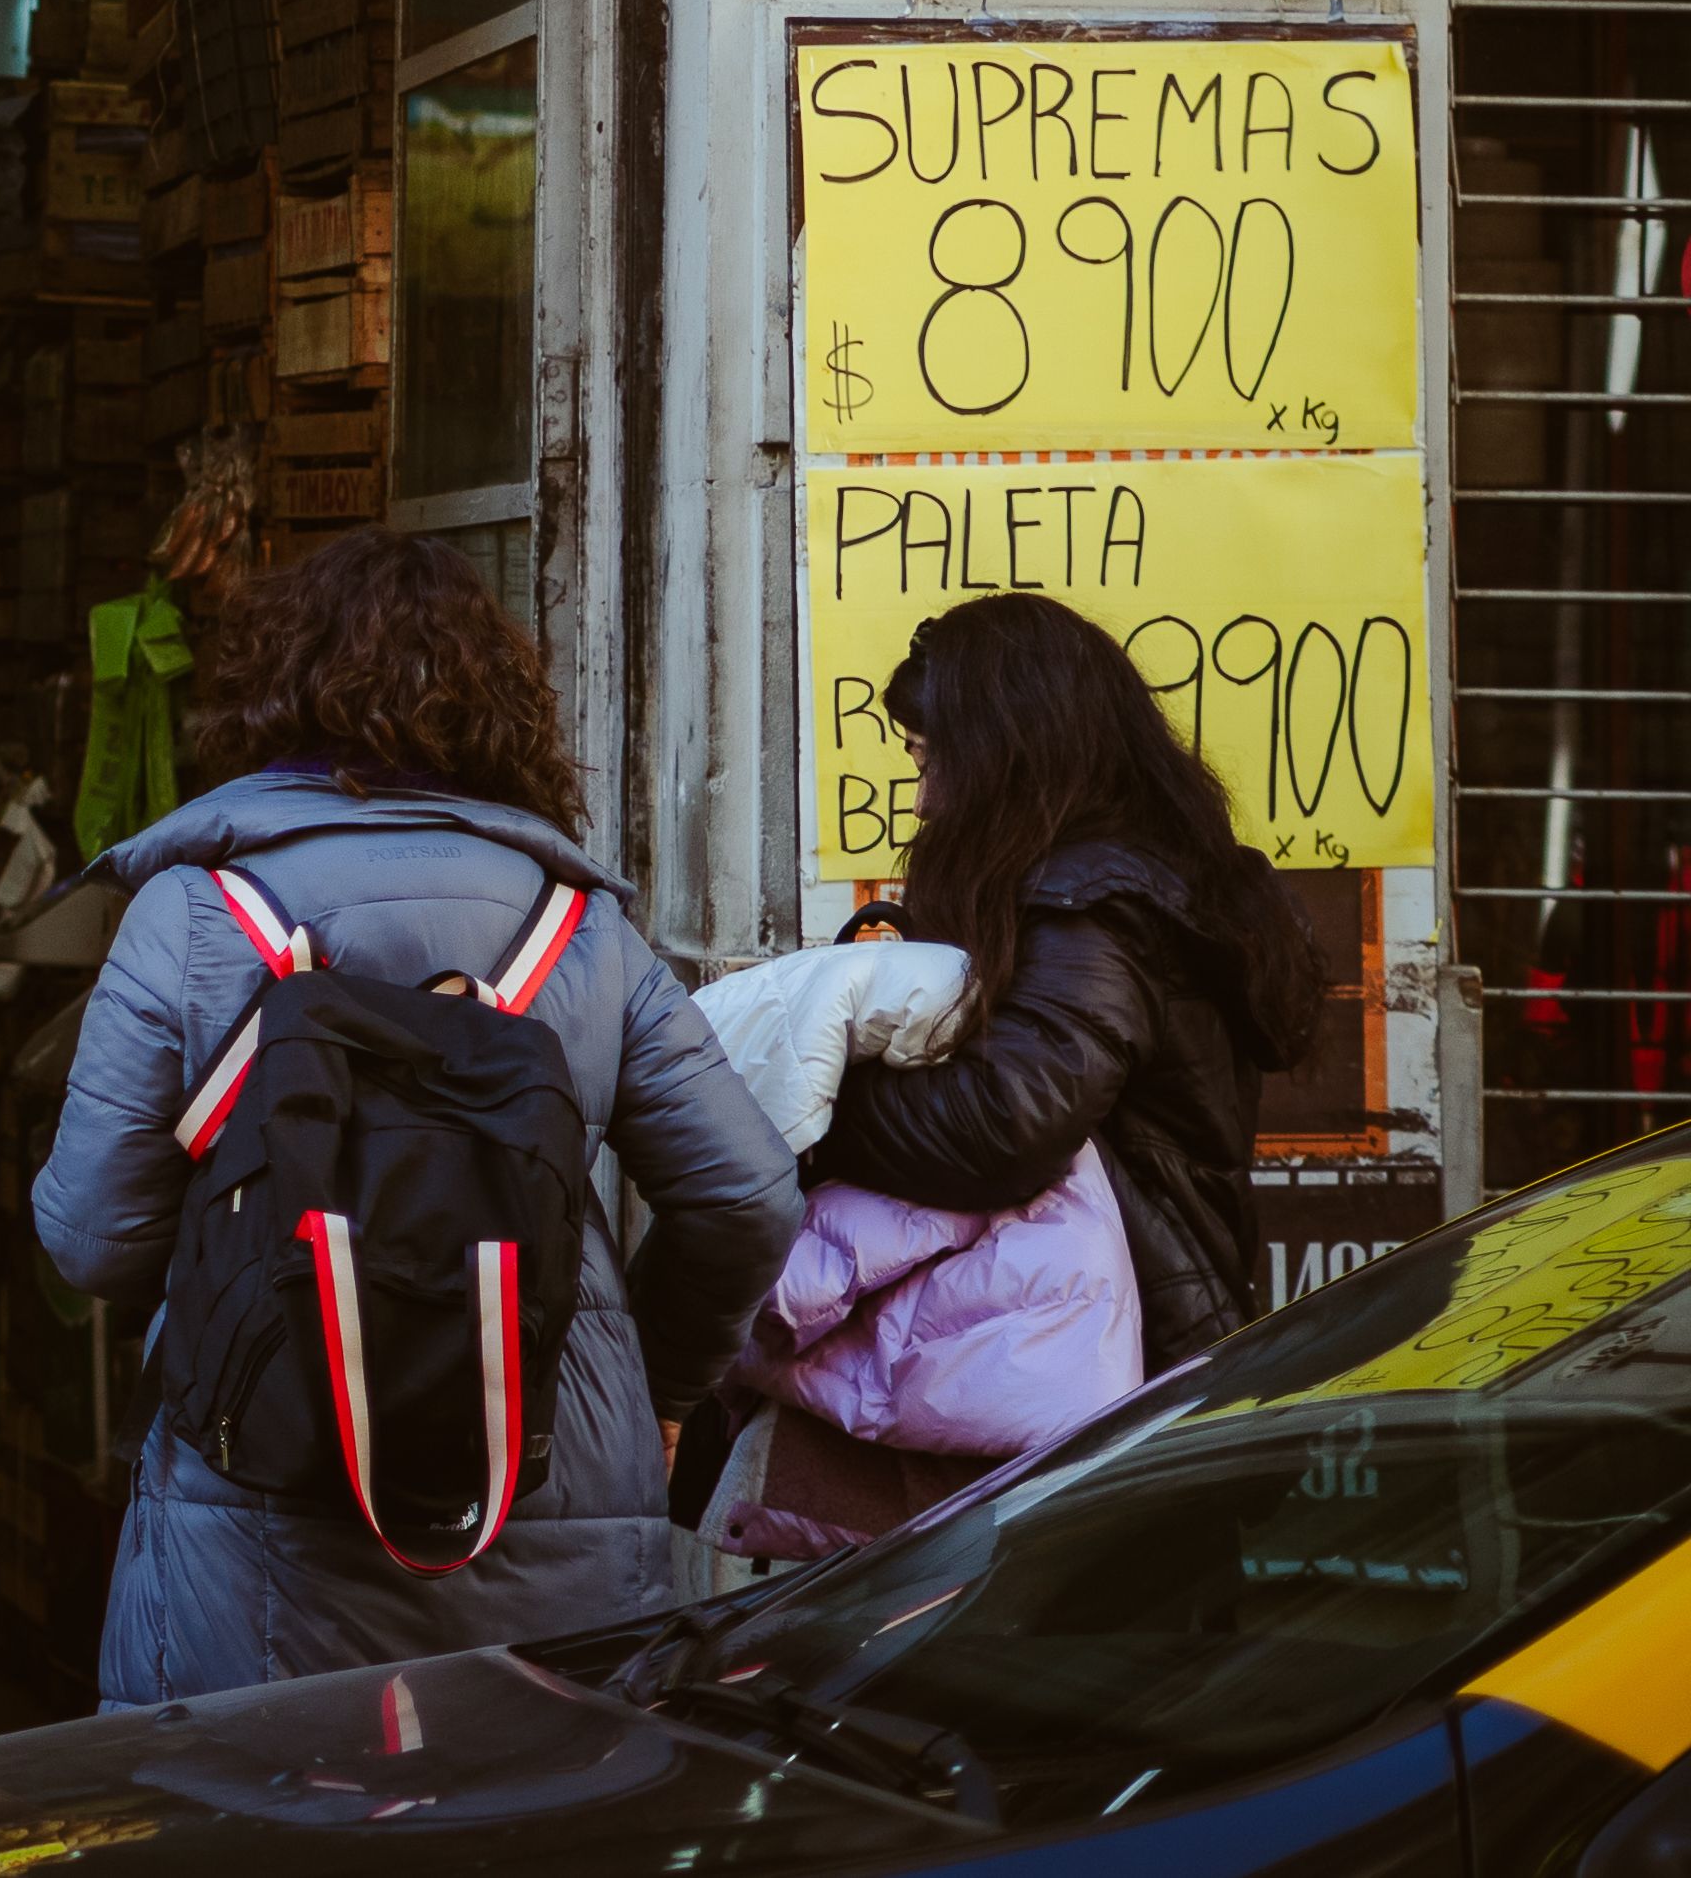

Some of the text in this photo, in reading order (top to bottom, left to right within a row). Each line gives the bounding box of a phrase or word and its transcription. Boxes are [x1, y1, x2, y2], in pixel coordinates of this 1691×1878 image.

[811, 59, 1380, 184] SUPREMAS
[822, 195, 1296, 425] $ 8900
[835, 483, 1147, 600] PALETA
[1123, 615, 1411, 822] 9900
[365, 844, 462, 863] PORTSAID
